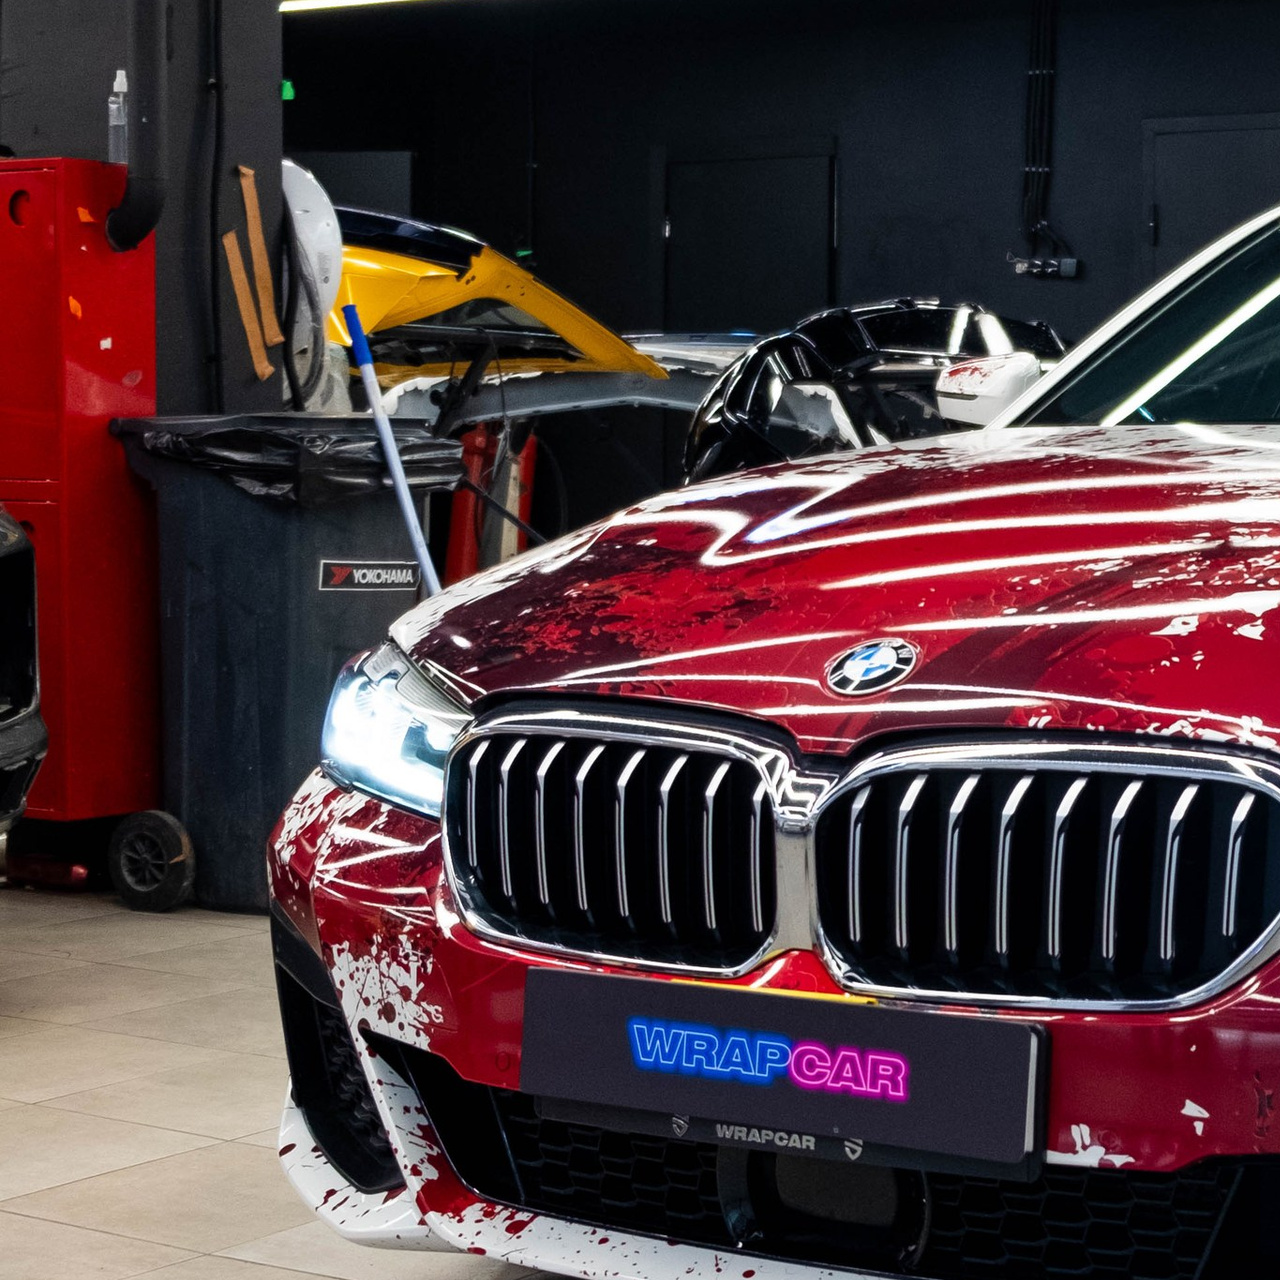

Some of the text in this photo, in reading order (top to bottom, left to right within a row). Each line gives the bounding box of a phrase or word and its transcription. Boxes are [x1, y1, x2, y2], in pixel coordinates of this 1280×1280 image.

[353, 569, 414, 584] YOKOHAMA
[632, 1023, 906, 1097] WRAPCAR
[716, 1123, 816, 1150] WRAPCAR
